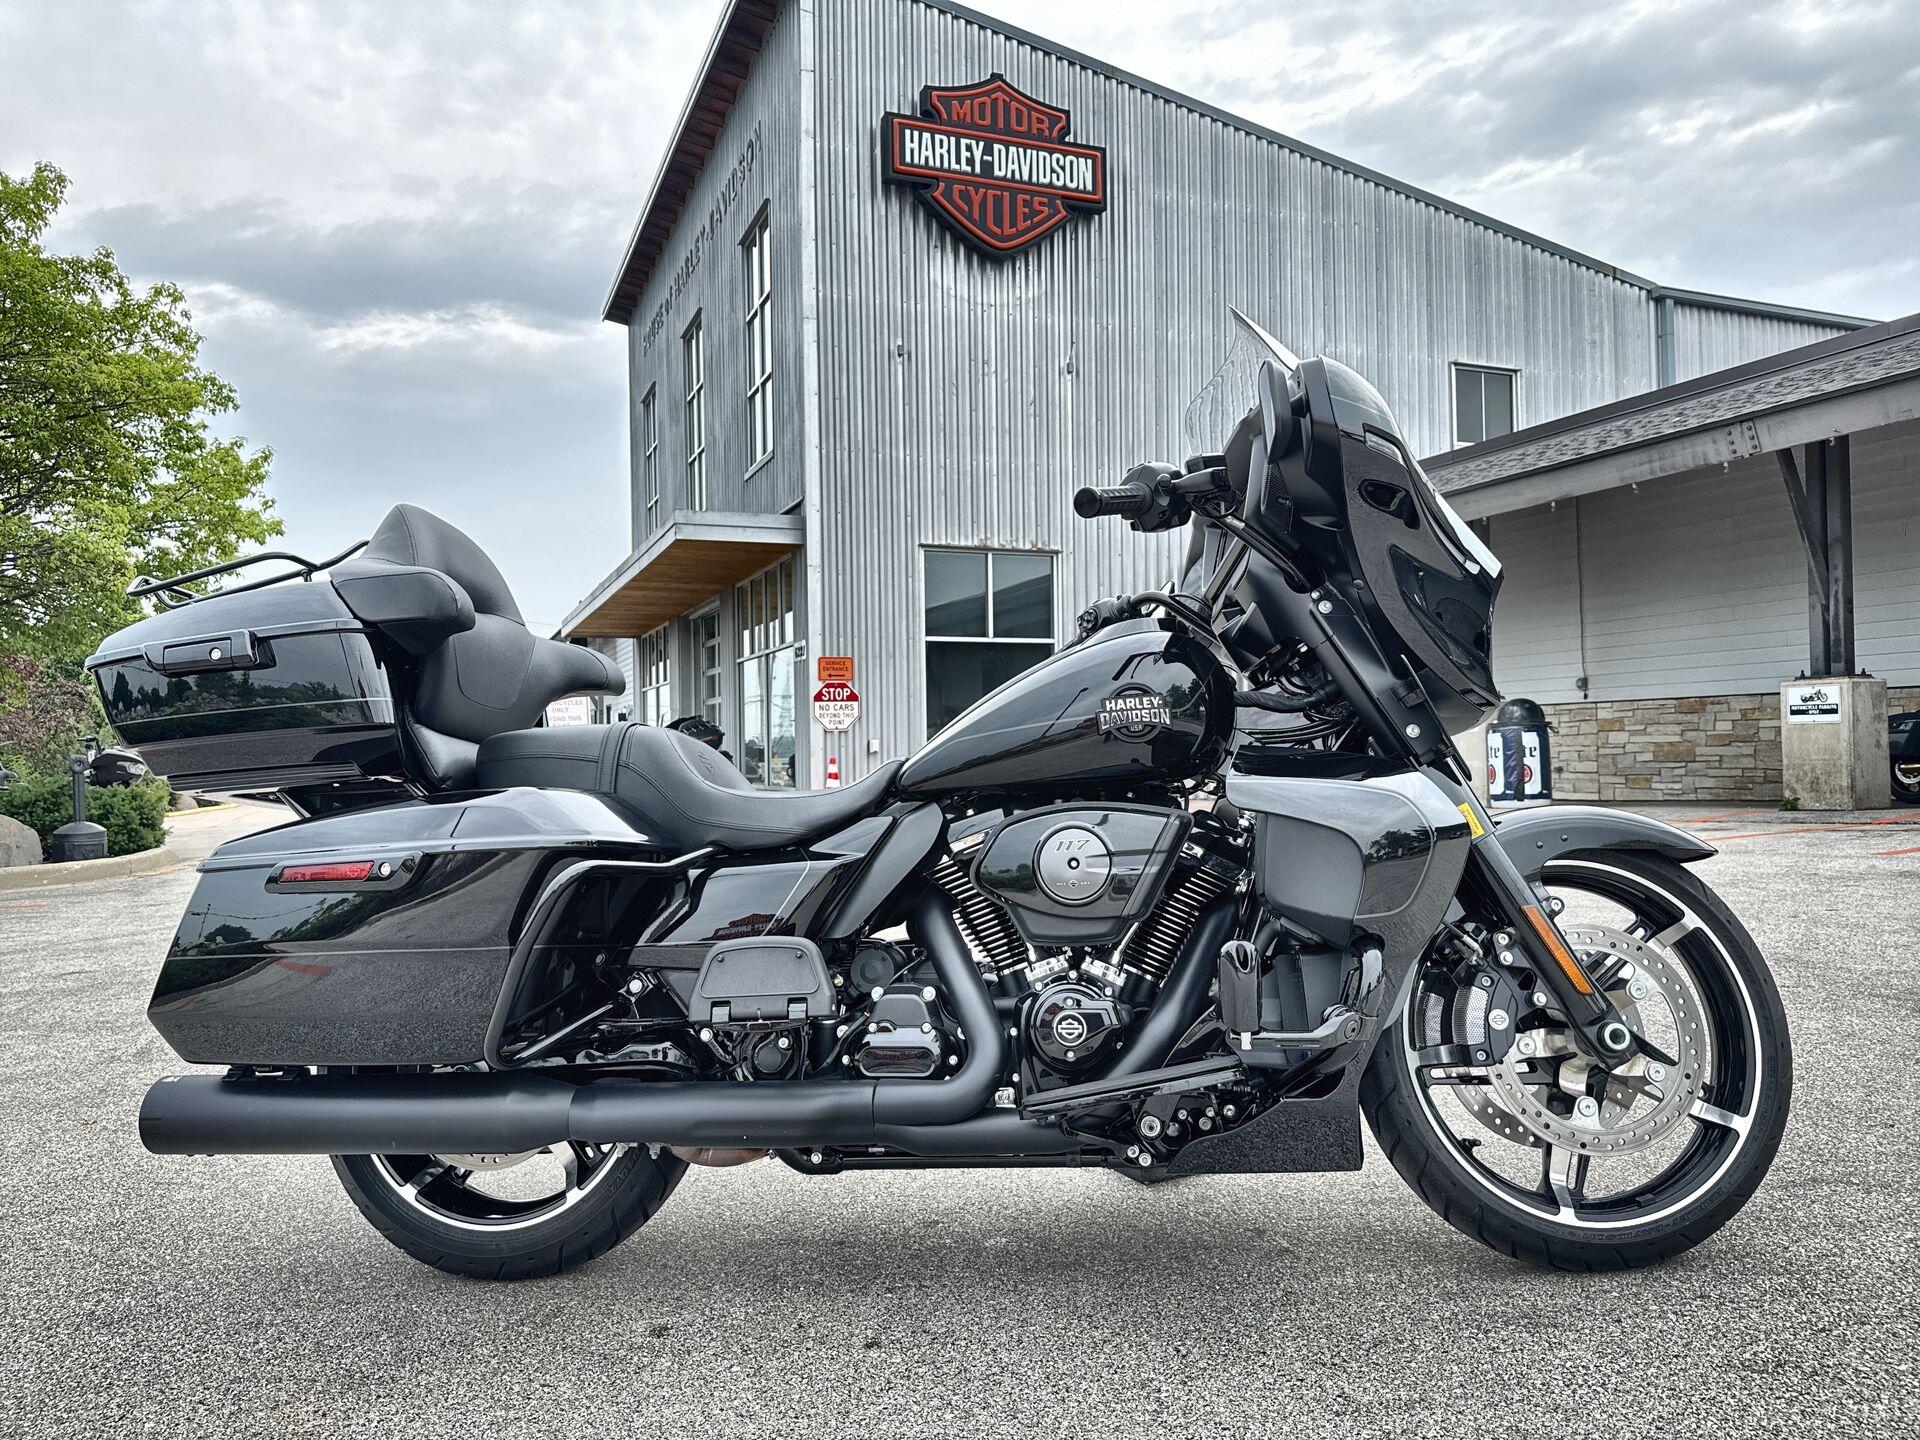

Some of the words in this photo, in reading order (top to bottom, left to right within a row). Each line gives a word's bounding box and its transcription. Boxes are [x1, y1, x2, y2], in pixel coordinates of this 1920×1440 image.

[952, 92, 1049, 138] MOTOR
[904, 128, 1093, 192] HARLEY-DAVIDSON
[952, 183, 1049, 236] CYCLES
[822, 688, 851, 701] STOP
[1105, 696, 1162, 711] HARLEY-
[1100, 708, 1171, 730] DAVIDSON
[1055, 839, 1091, 852] 117
